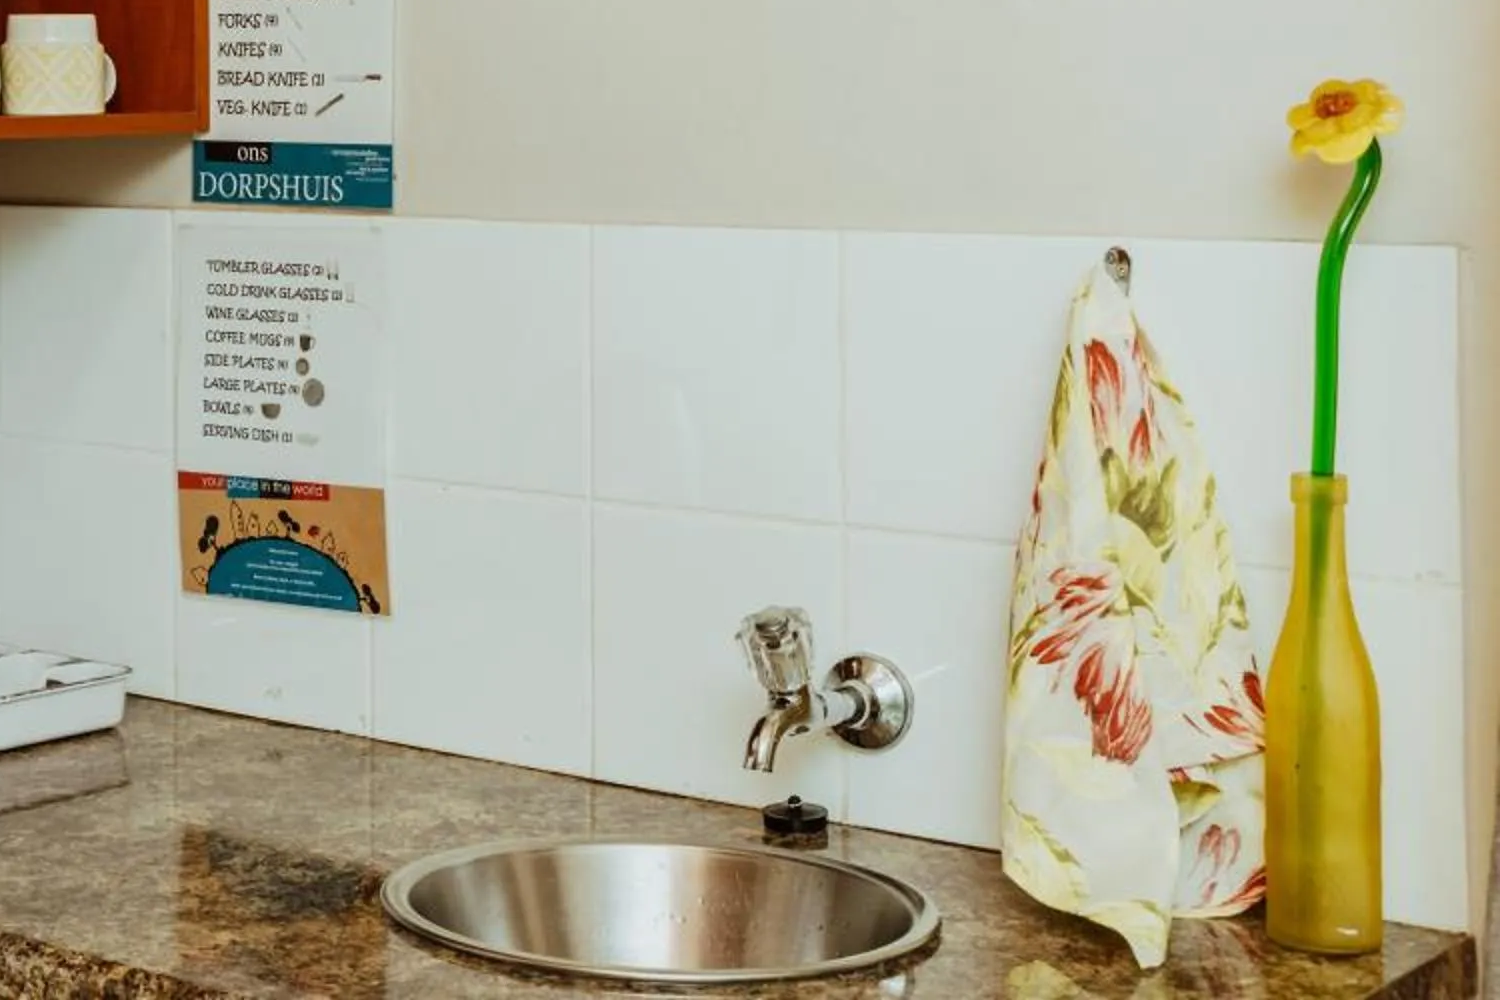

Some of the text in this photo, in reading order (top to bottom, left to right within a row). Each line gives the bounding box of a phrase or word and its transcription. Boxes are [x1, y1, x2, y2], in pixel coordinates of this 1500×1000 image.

[218, 14, 262, 28] FORKS
[218, 43, 266, 58] KNIFES
[218, 70, 264, 87] BREAD
[268, 72, 308, 86] KNIFE
[252, 101, 290, 116] KNIFE
[237, 145, 268, 161] ons
[200, 172, 344, 202] DORPSHUIS
[207, 260, 258, 274] TUMBLER
[261, 262, 309, 276] GLASSES
[207, 284, 238, 297] COLD
[241, 285, 277, 298] DRINK
[280, 287, 328, 301] GLASSES
[206, 306, 234, 320] WINE
[236, 308, 284, 322] GLASSES
[206, 330, 245, 345] COFFEE
[204, 354, 228, 366] SIDE
[232, 355, 274, 370] PLATES
[204, 377, 240, 391] LARGE
[244, 379, 287, 395] PLATES
[203, 400, 240, 414] BOWLS
[203, 424, 249, 440] SERVING
[252, 428, 278, 442] DISH
[201, 477, 323, 496] your place in the world
